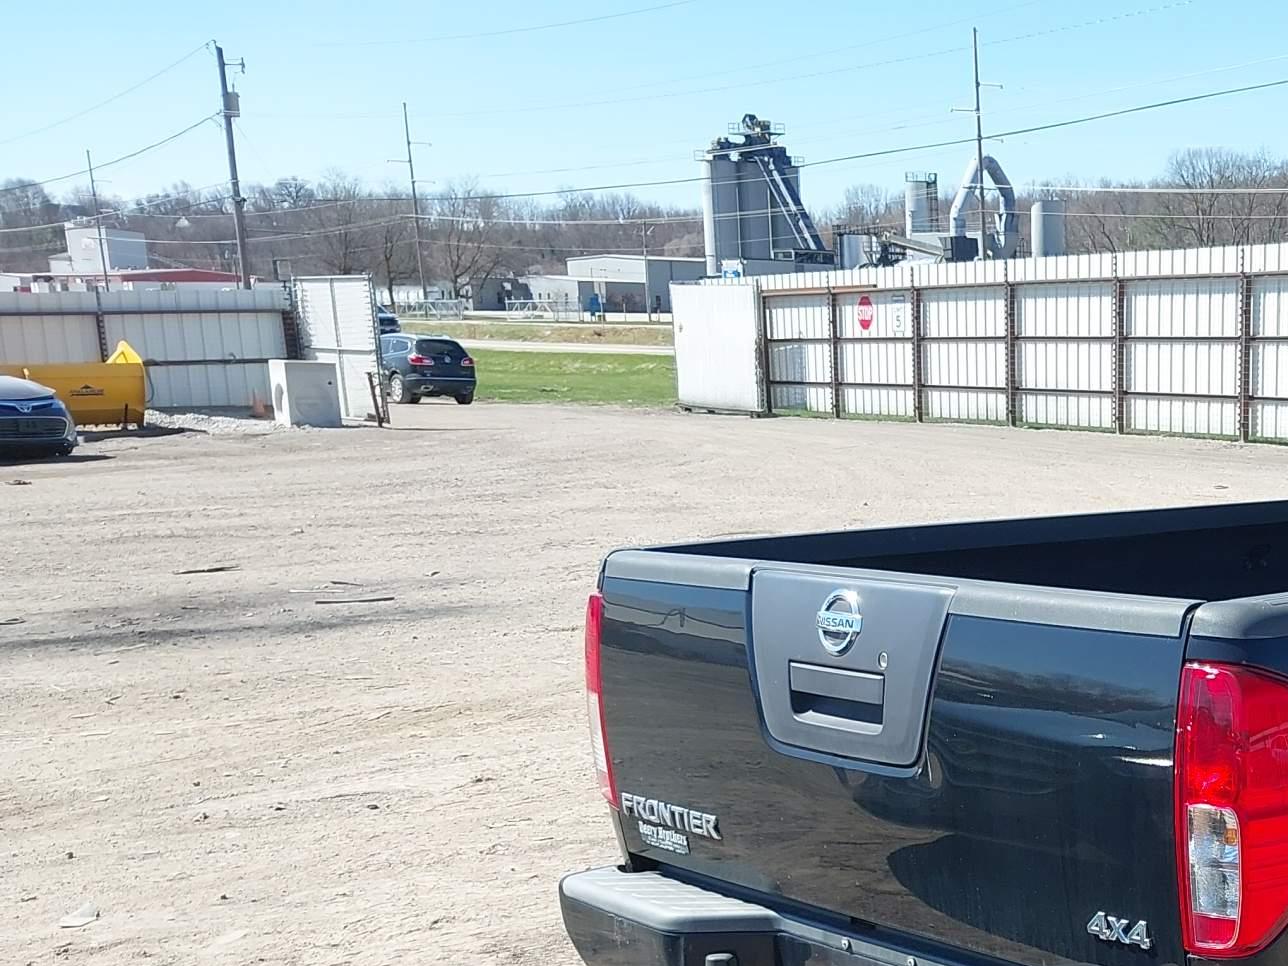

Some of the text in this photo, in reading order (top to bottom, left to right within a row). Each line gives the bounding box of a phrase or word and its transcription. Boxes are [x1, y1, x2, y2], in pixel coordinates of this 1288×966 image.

[857, 308, 873, 321] STOP
[896, 315, 901, 328] 5
[817, 615, 854, 628] NISSAN
[621, 792, 722, 840] FRONTIER
[1087, 911, 1151, 949] 4X4
